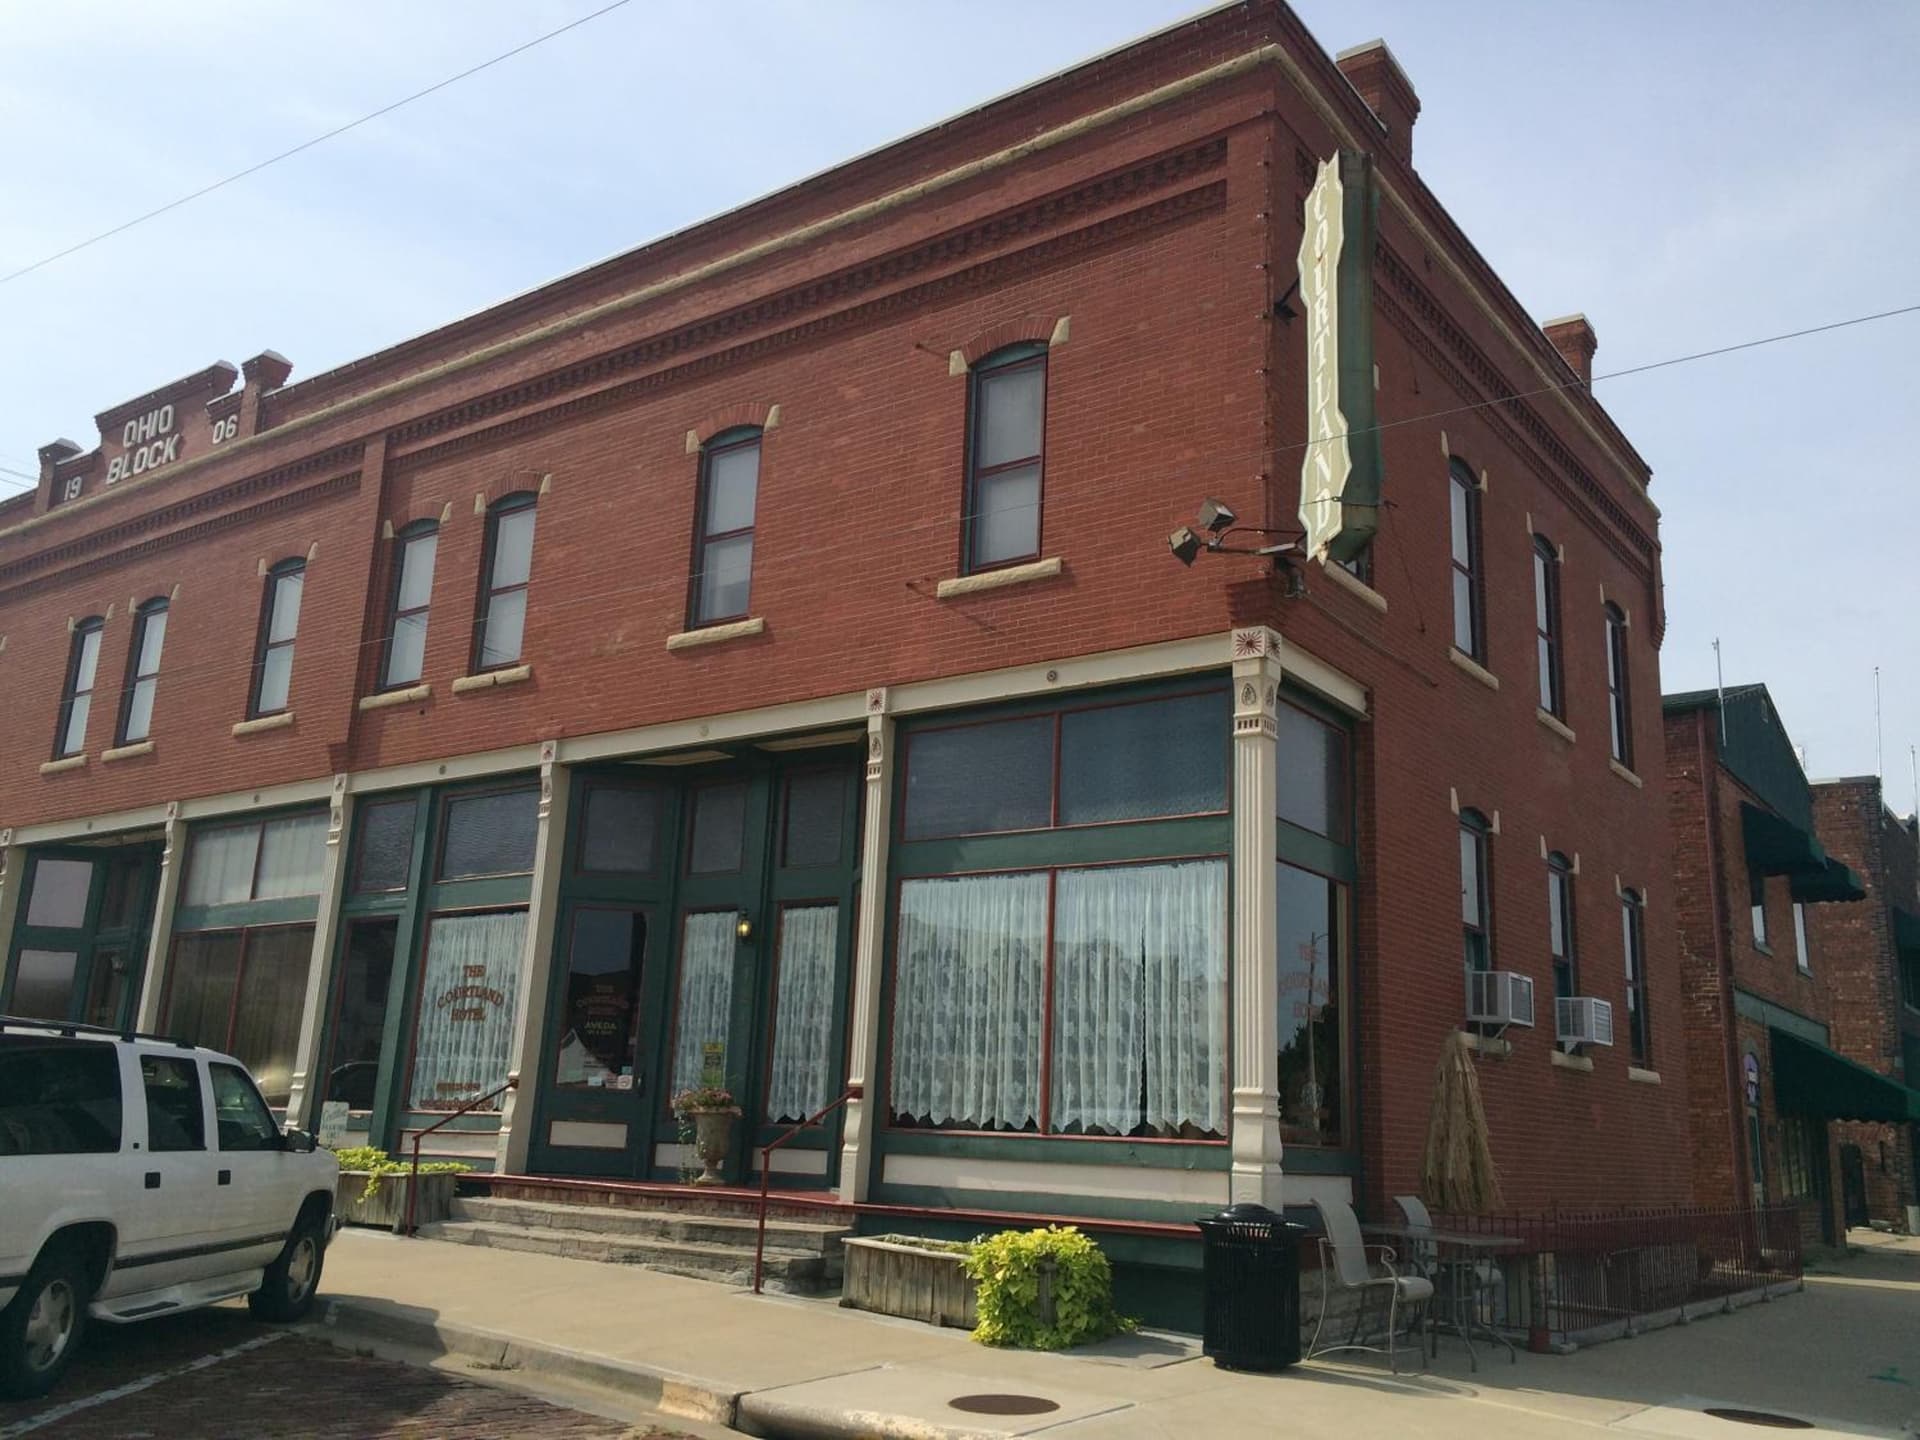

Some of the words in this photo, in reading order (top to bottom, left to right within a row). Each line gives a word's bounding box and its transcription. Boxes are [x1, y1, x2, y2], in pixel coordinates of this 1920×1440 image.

[1313, 180, 1332, 535] COURTLAND
[123, 404, 174, 448] OHIO
[212, 415, 239, 444] 06
[106, 433, 181, 484] BLOCK
[64, 476, 83, 501] 19
[463, 965, 485, 977] THE
[451, 1008, 486, 1021] HOTEL
